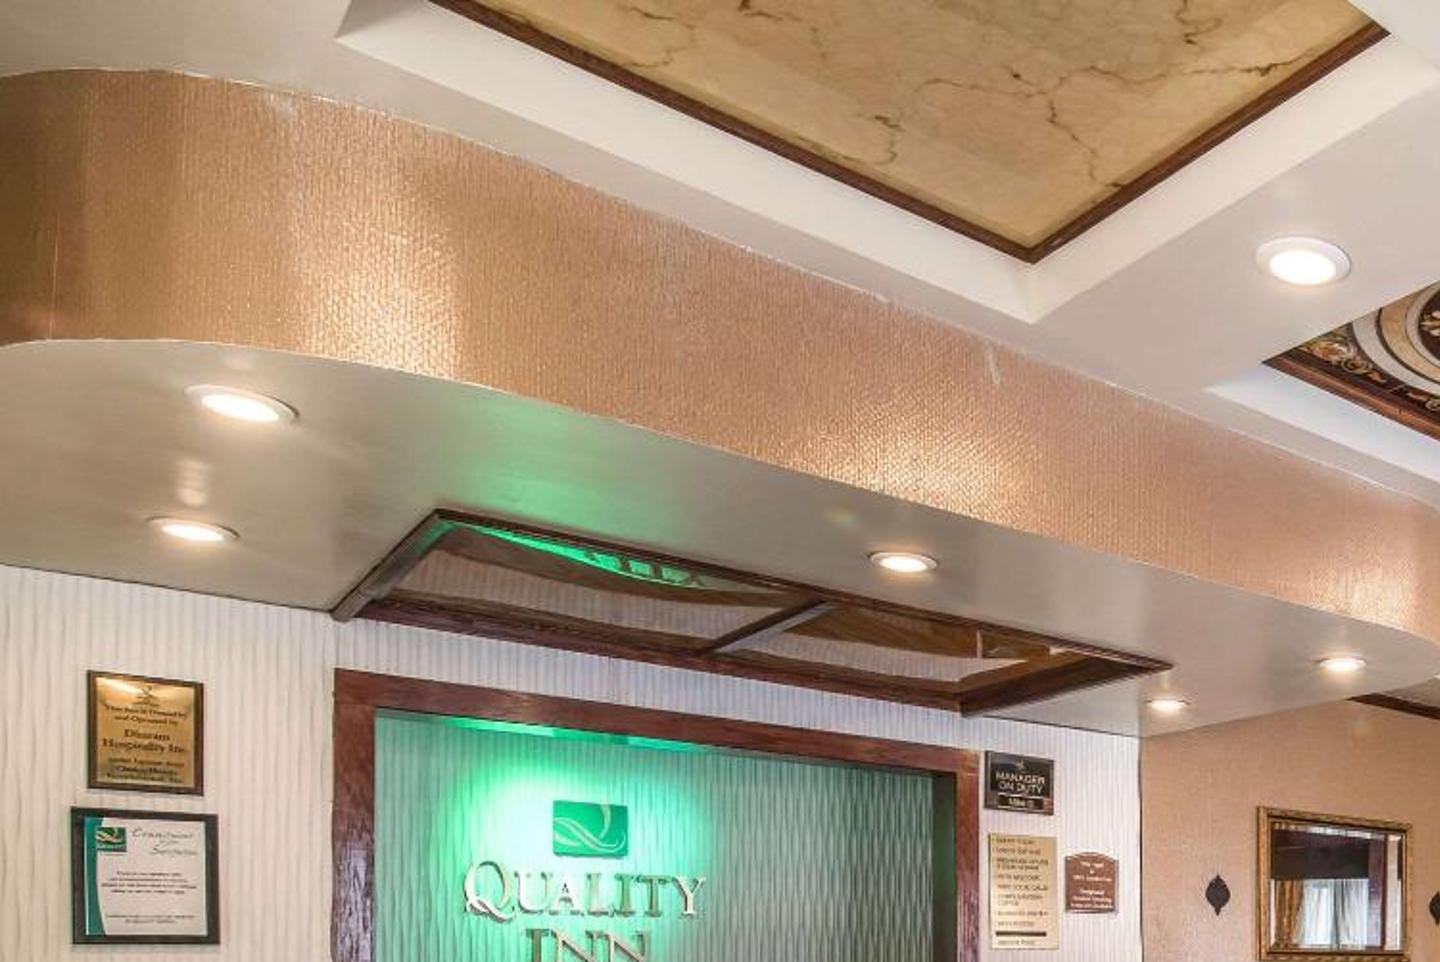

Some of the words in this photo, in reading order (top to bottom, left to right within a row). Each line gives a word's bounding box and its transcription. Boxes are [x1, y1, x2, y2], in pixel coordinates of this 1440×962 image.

[995, 770, 1045, 785] MANAGER
[998, 780, 1014, 791] ON
[1016, 782, 1043, 794] DUTY
[463, 860, 706, 923] QUALITY
